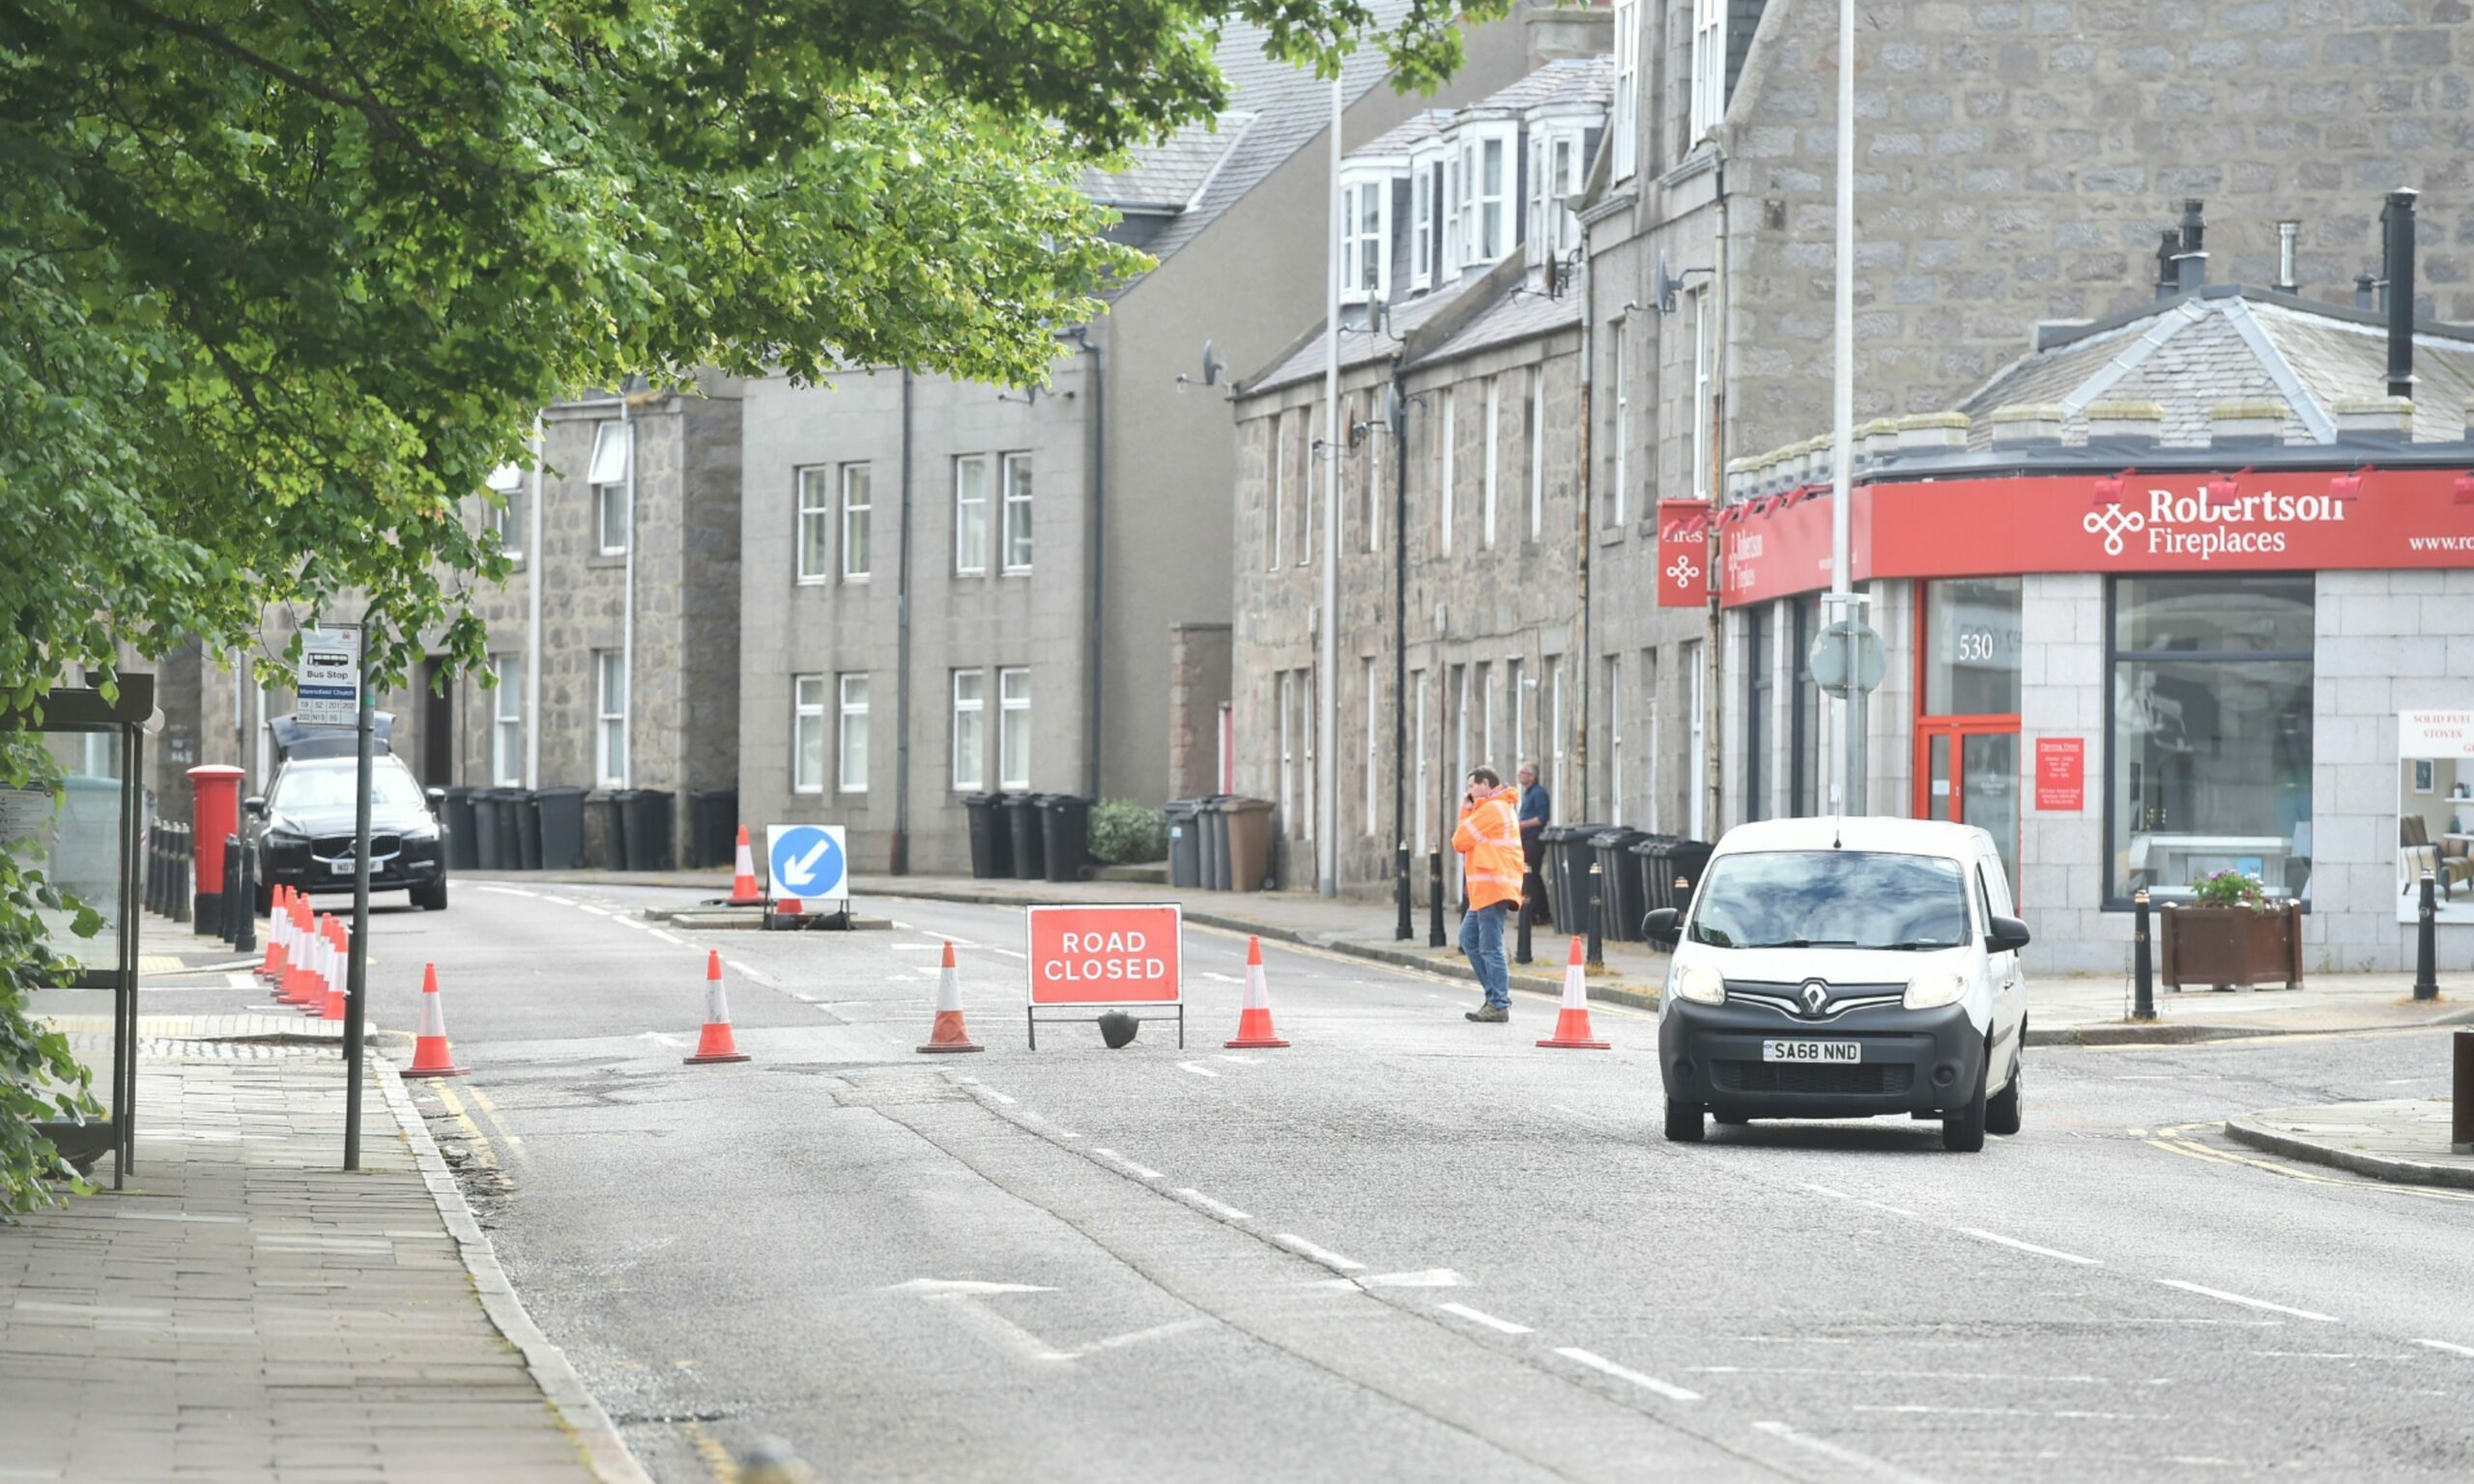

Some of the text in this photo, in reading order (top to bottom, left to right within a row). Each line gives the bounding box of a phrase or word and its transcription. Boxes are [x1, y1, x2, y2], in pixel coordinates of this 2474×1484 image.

[2147, 486, 2345, 524] Robertson
[1664, 529, 1704, 543] ires
[2147, 526, 2287, 560] Fireplaces
[1958, 633, 1993, 662] 530
[306, 670, 349, 680] Bus Stop
[332, 688, 355, 697] Church
[1063, 931, 1146, 954] ROAD
[1044, 958, 1165, 981] CLOSED
[1774, 1042, 1857, 1060] SA68 NND
